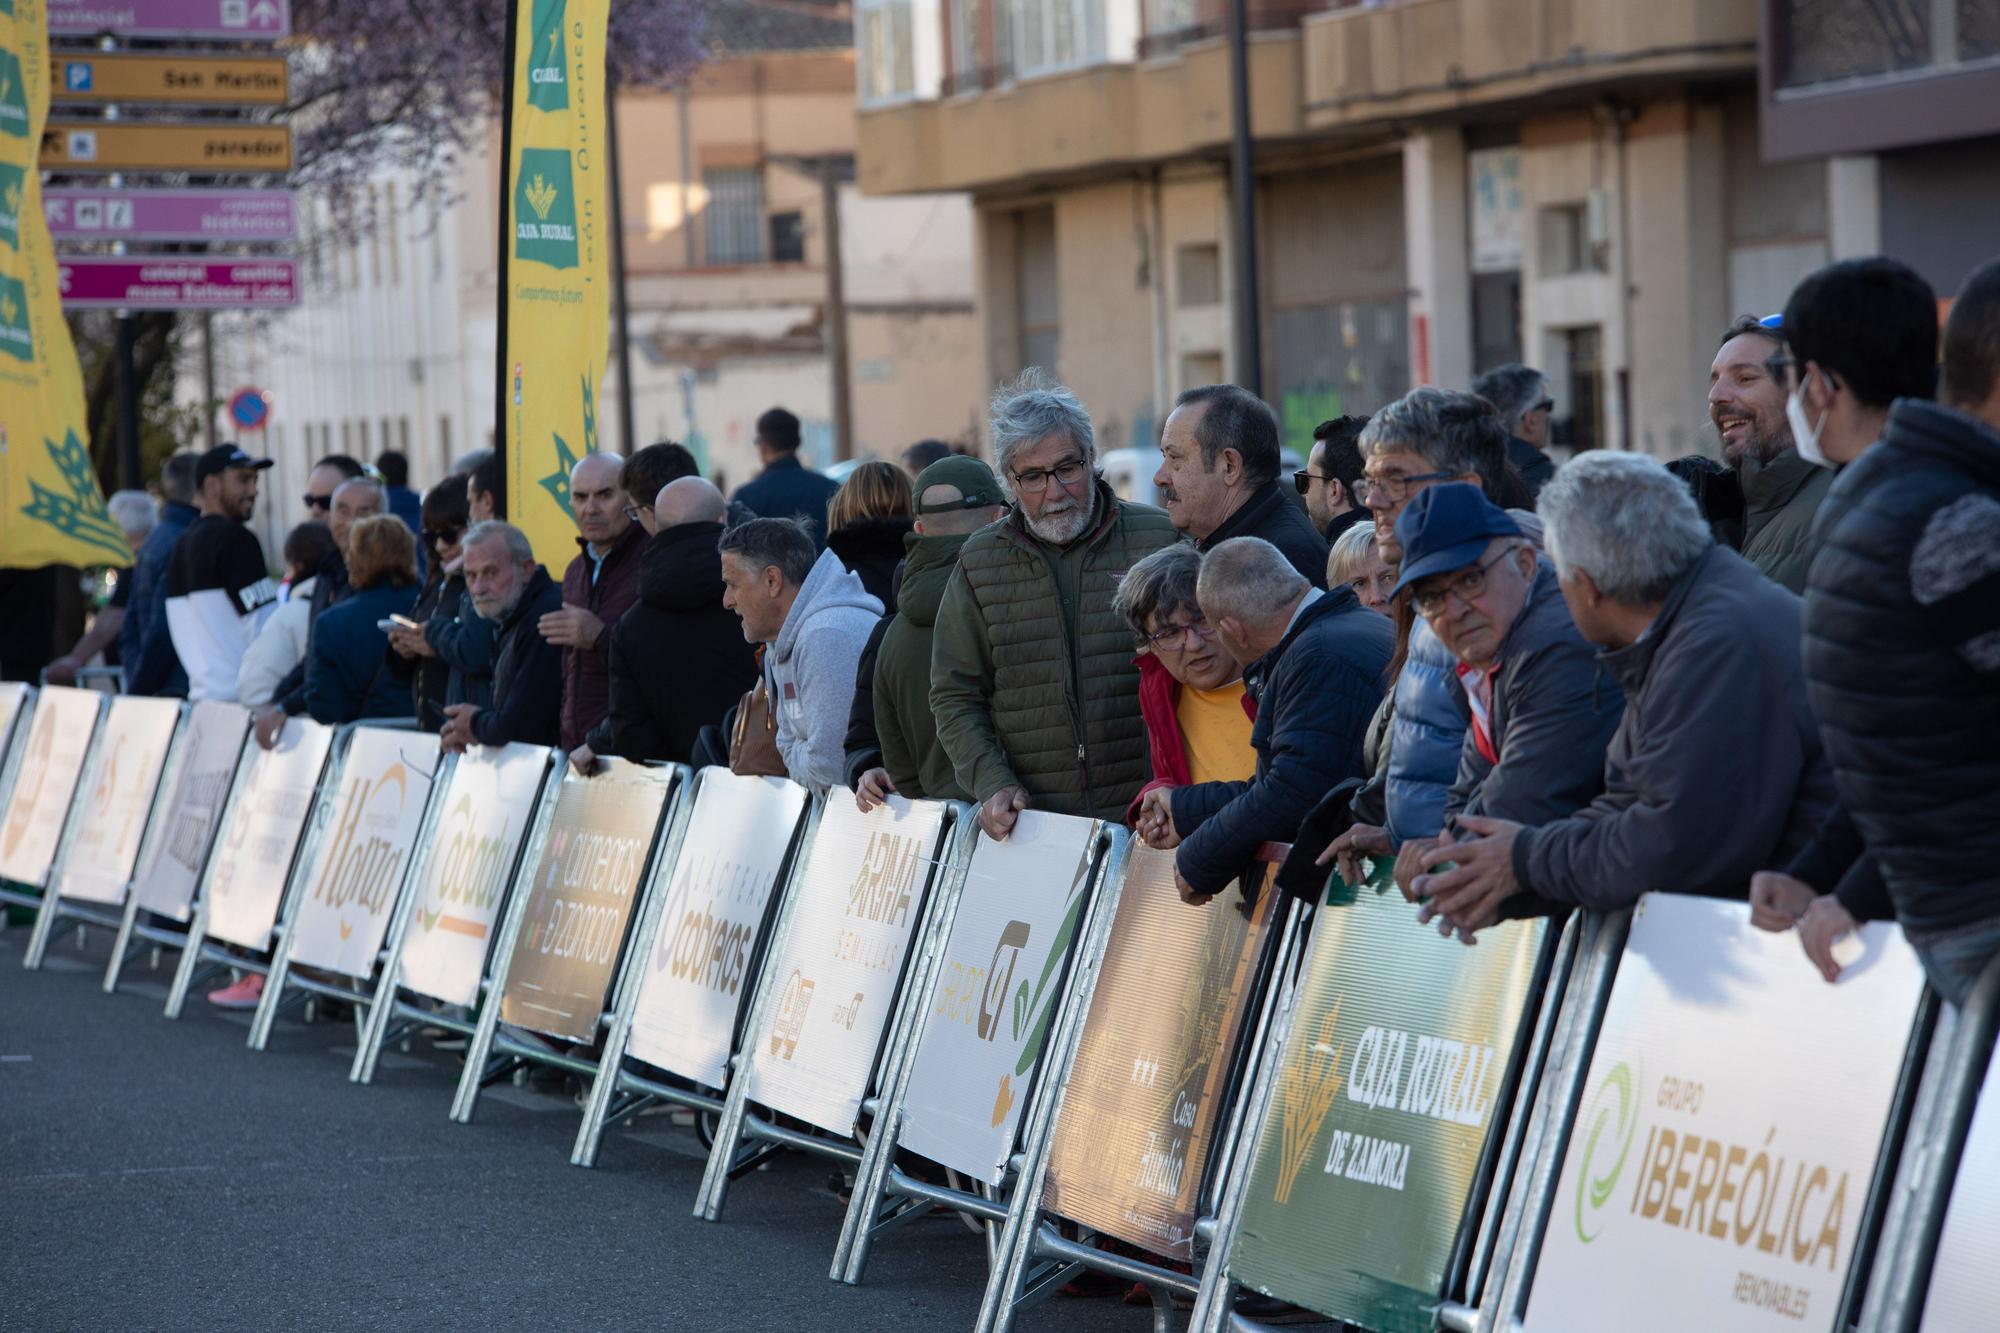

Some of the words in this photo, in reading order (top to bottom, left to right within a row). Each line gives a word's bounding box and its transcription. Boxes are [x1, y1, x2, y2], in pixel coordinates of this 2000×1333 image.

[164, 69, 203, 88] San
[205, 139, 282, 158] parador
[139, 264, 207, 282] catedral
[230, 265, 290, 282] castillo
[182, 284, 249, 299] Baltasar
[253, 285, 290, 299] Lobo
[314, 777, 403, 916] Honza
[845, 831, 922, 929] ARIMA
[555, 903, 620, 966] zamora
[670, 899, 752, 996] cobreros
[833, 928, 898, 974] SEMILLAS
[1346, 1025, 1409, 1110] CAJA
[1401, 1035, 1494, 1127] RURAL
[1656, 1075, 1705, 1115] GRUPO
[1173, 1090, 1197, 1129] Casa
[1324, 1129, 1353, 1175] DE
[1345, 1135, 1411, 1191] ZAMORA
[1630, 1125, 1850, 1272] IBEREÓLICA
[1733, 1271, 1812, 1319] RENOVABLES
